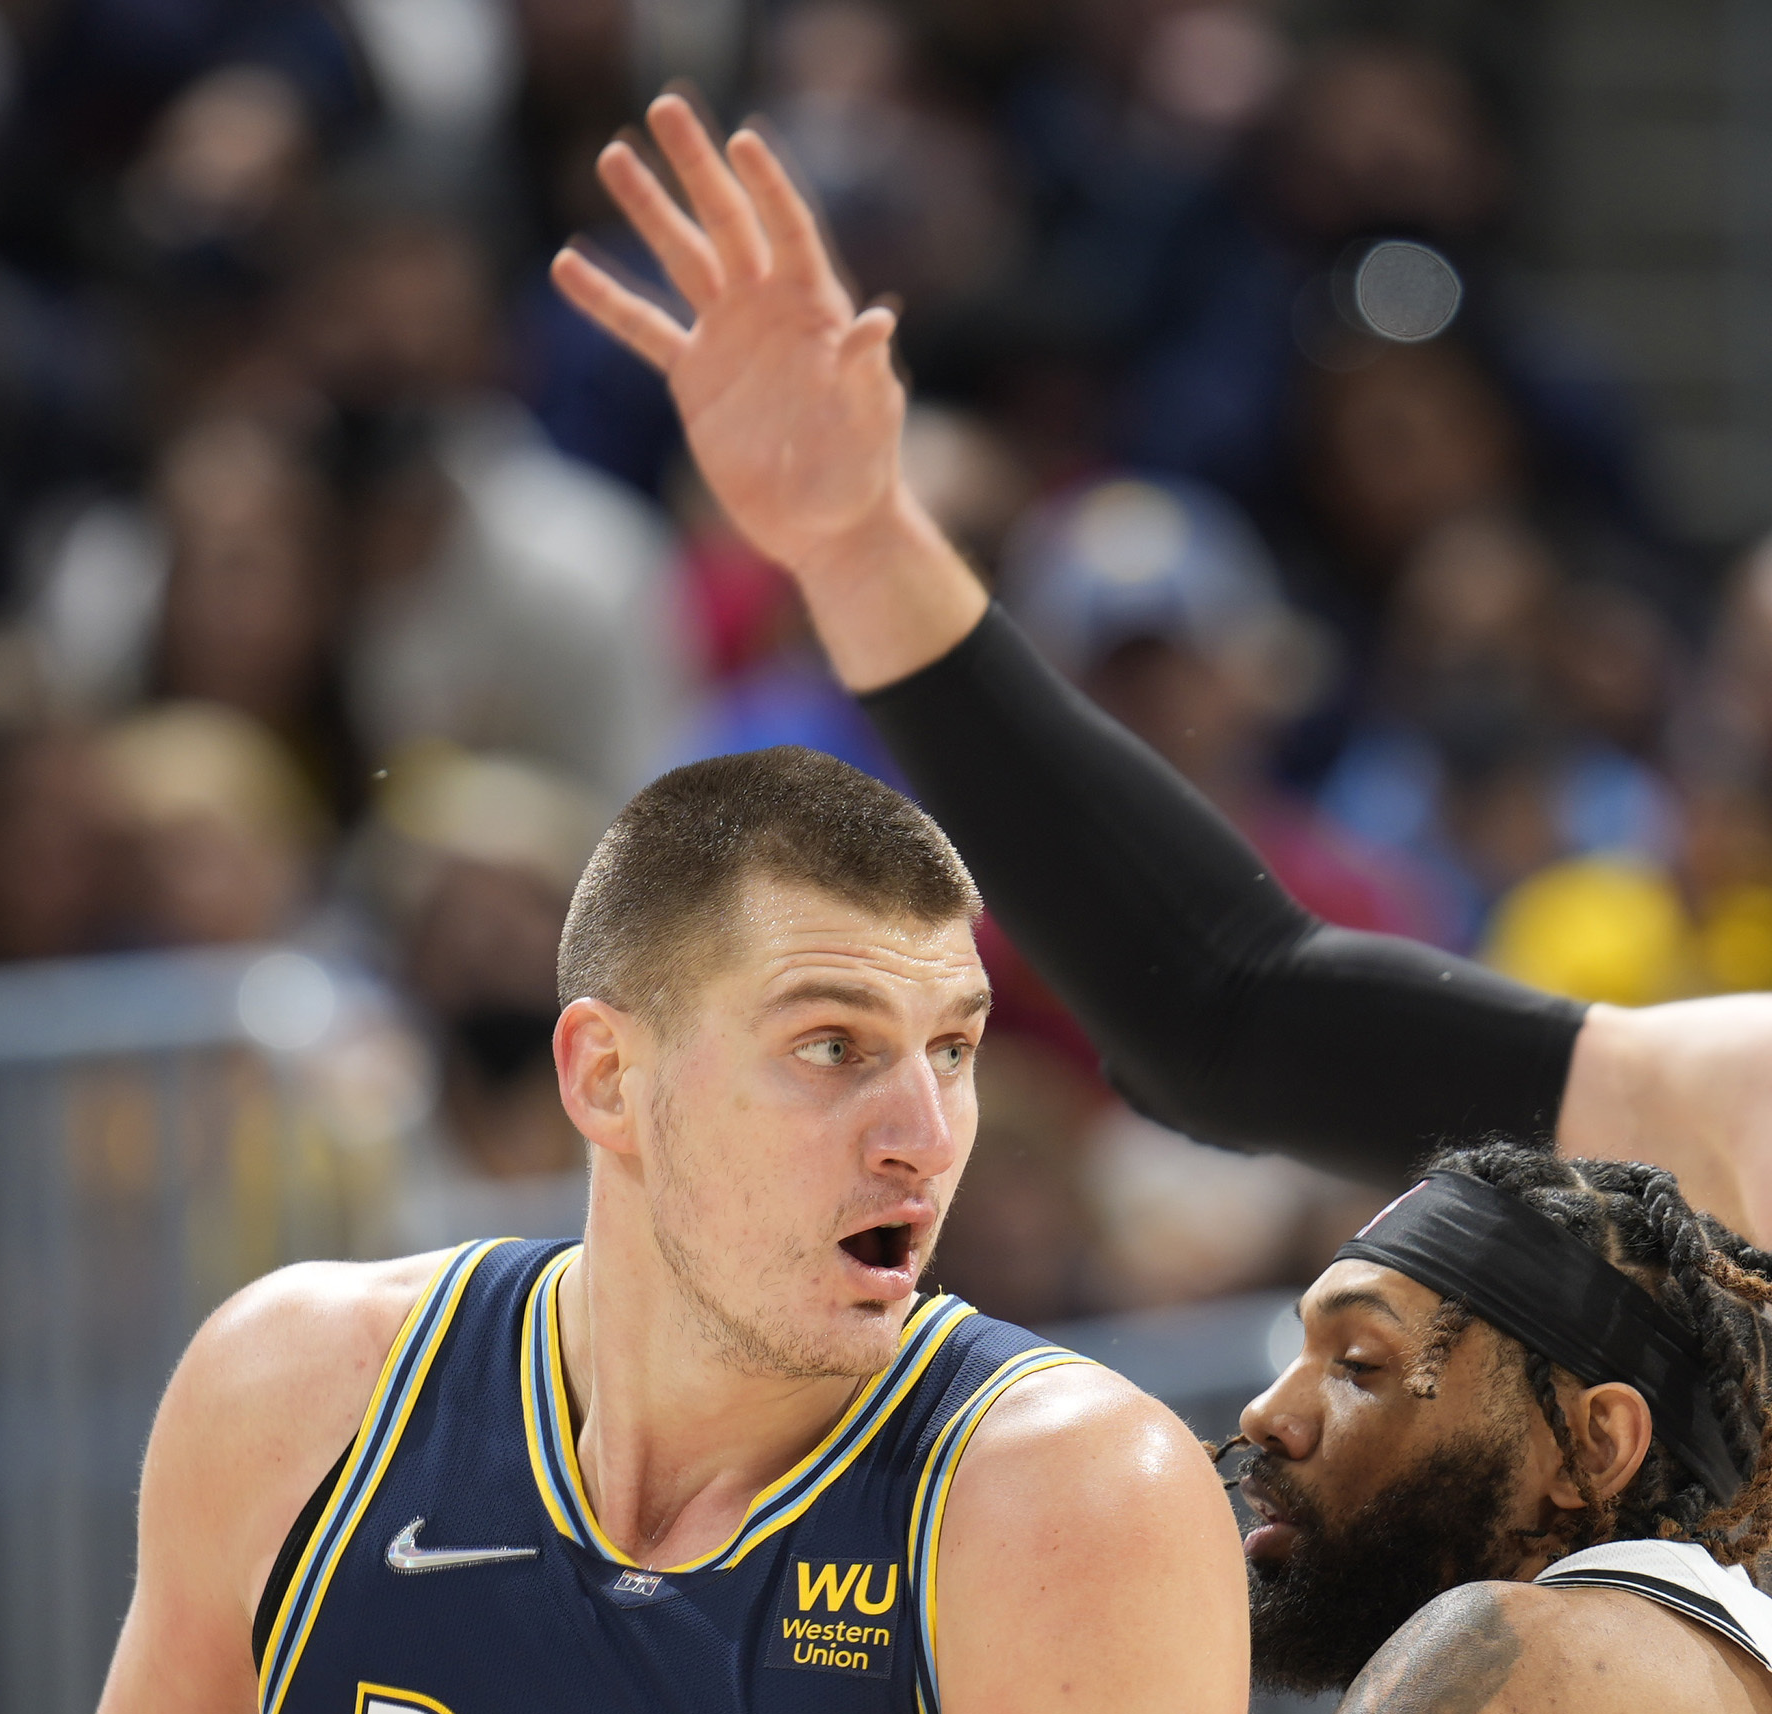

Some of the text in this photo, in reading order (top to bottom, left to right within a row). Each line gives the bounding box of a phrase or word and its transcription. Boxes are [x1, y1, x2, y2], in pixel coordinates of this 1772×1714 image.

[797, 1561, 899, 1616] WU
[782, 1617, 890, 1647] Western
[793, 1642, 869, 1671] Union
